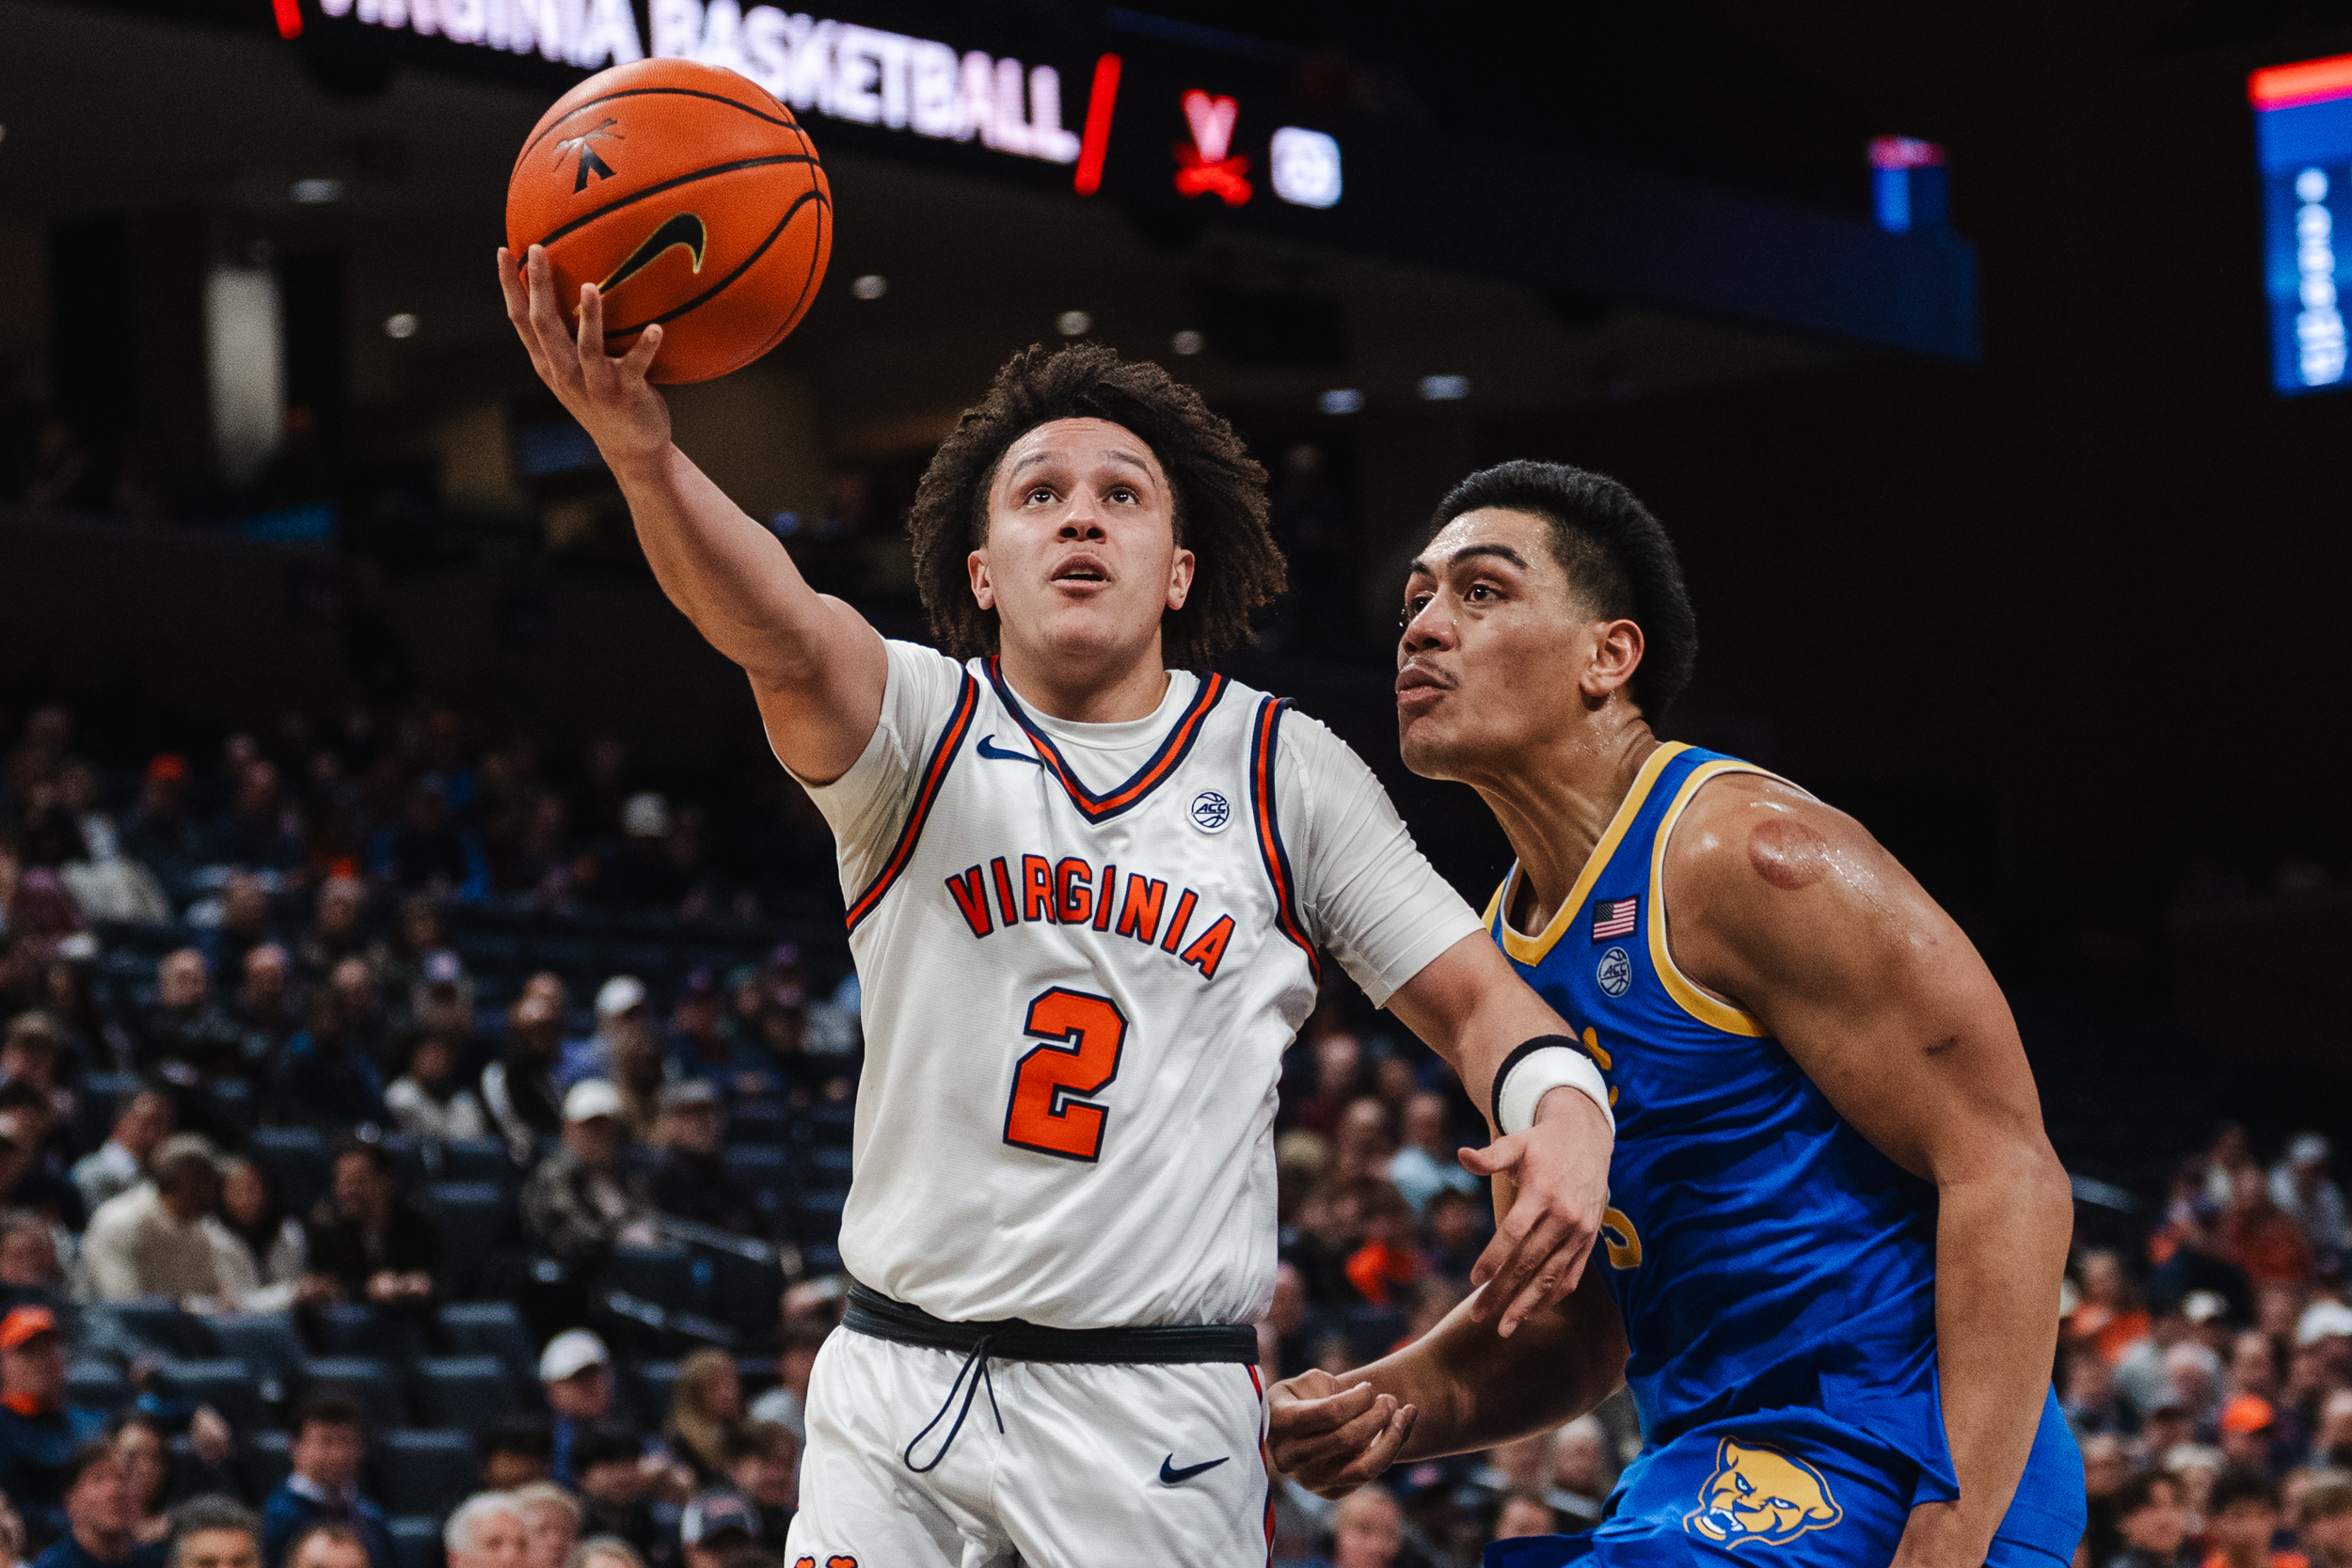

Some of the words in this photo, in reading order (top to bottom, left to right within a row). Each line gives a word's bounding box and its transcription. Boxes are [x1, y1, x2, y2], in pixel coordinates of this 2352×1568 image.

[1195, 802, 1227, 815] ACC
[945, 853, 1236, 980] VIRGINIA
[1602, 961, 1628, 978] ACC
[1003, 986, 1129, 1163] 2
